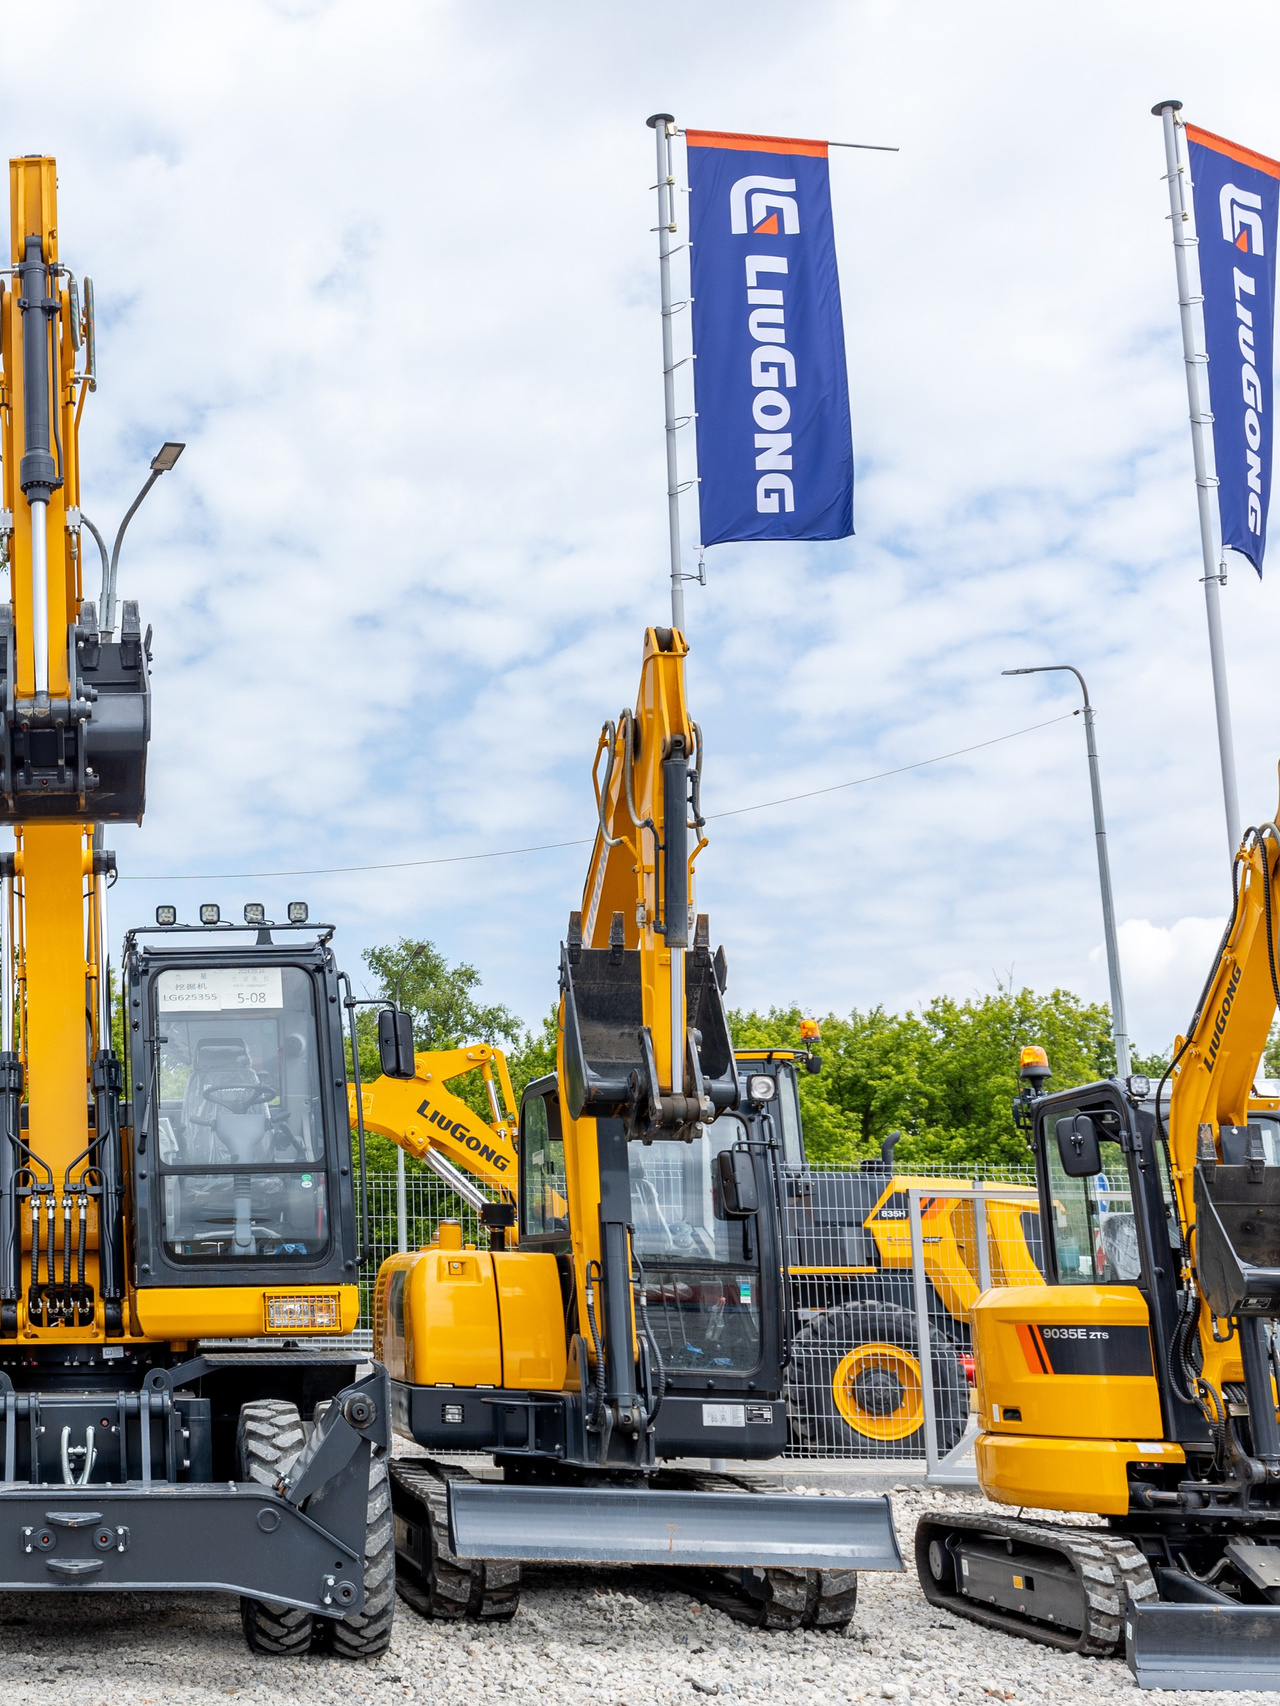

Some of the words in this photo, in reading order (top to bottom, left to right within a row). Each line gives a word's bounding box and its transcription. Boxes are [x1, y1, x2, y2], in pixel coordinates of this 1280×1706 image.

[745, 255, 797, 514] LIUGONG
[1233, 266, 1263, 536] LIUGONG
[237, 992, 266, 1003] 5-08
[881, 1210, 906, 1218] 835H
[1043, 1328, 1087, 1339] 9035E
[1088, 1331, 1109, 1340] ZTS
